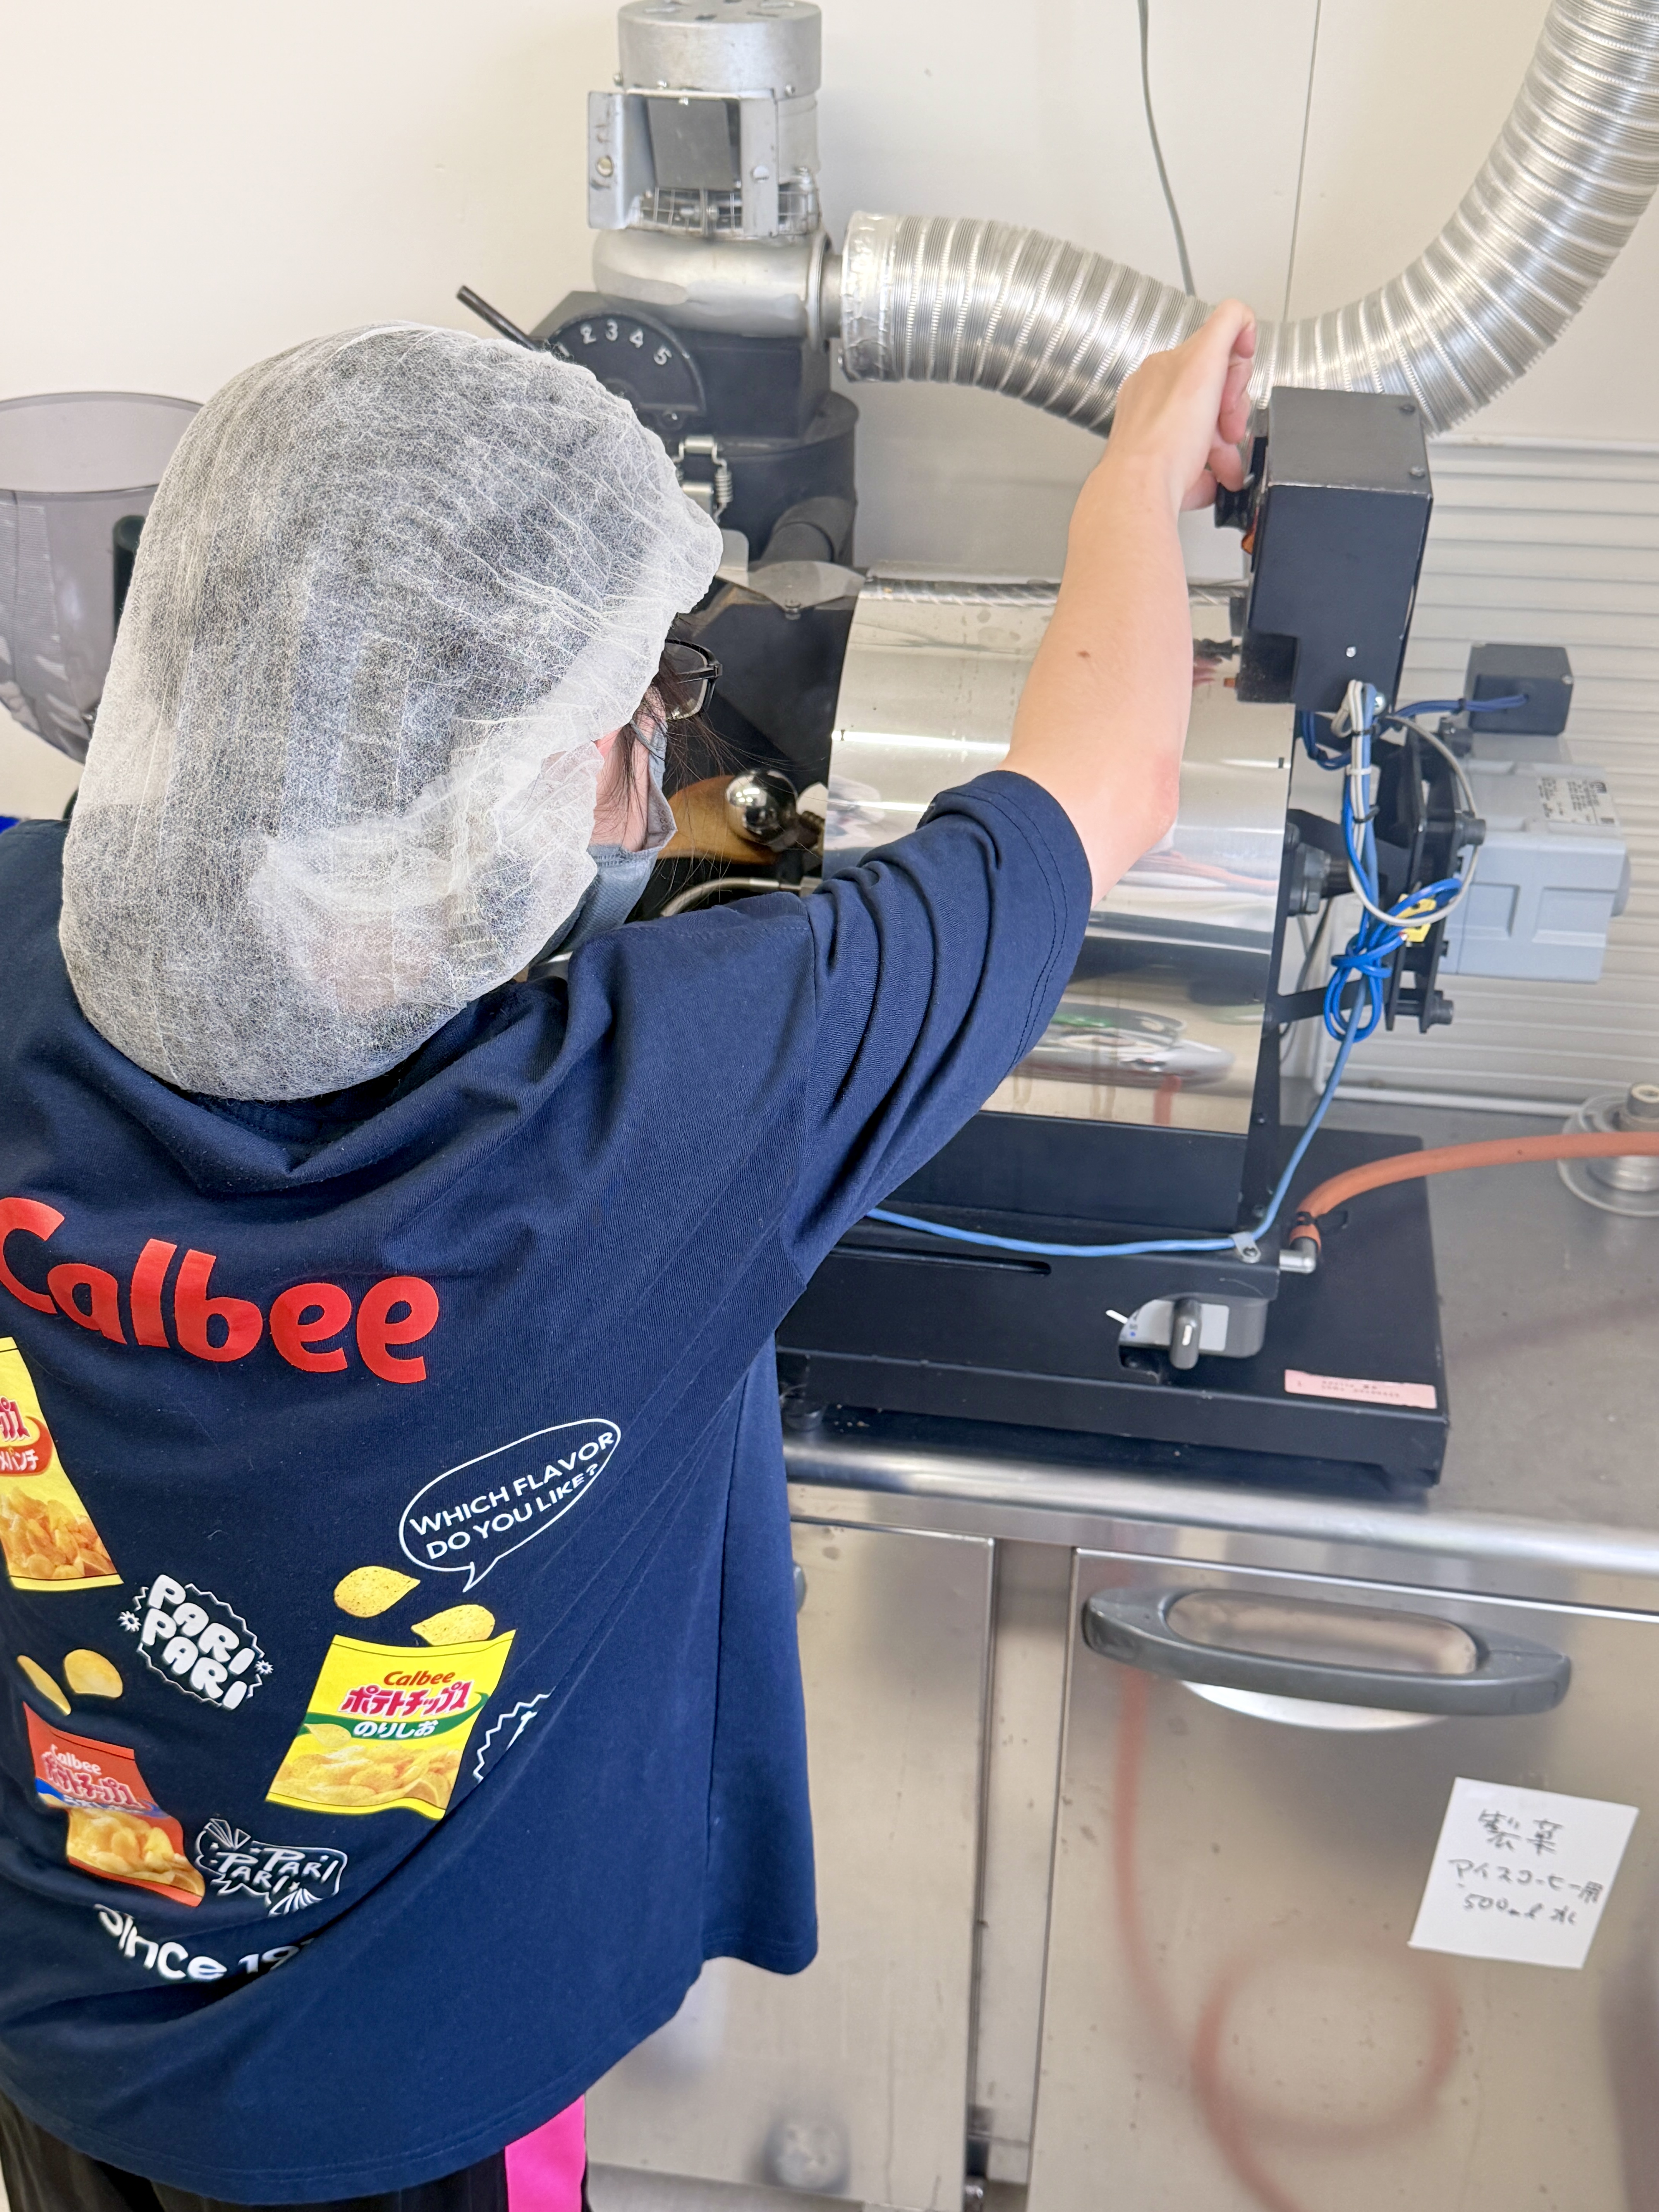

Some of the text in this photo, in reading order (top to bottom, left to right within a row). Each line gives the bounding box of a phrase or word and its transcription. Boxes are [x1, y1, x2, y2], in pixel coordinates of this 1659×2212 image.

[580, 324, 597, 345] 2
[605, 318, 618, 342] 3
[629, 328, 644, 349] 4
[653, 344, 672, 365] 5
[0, 1197, 439, 1383] Calbee
[410, 1432, 614, 1535] WHICH FLAVOR
[426, 1463, 598, 1559] DO YOU LIKE?
[338, 1680, 474, 1718] ポテトチップス
[383, 1670, 455, 1686] Calbee
[353, 1720, 439, 1738] のりしお
